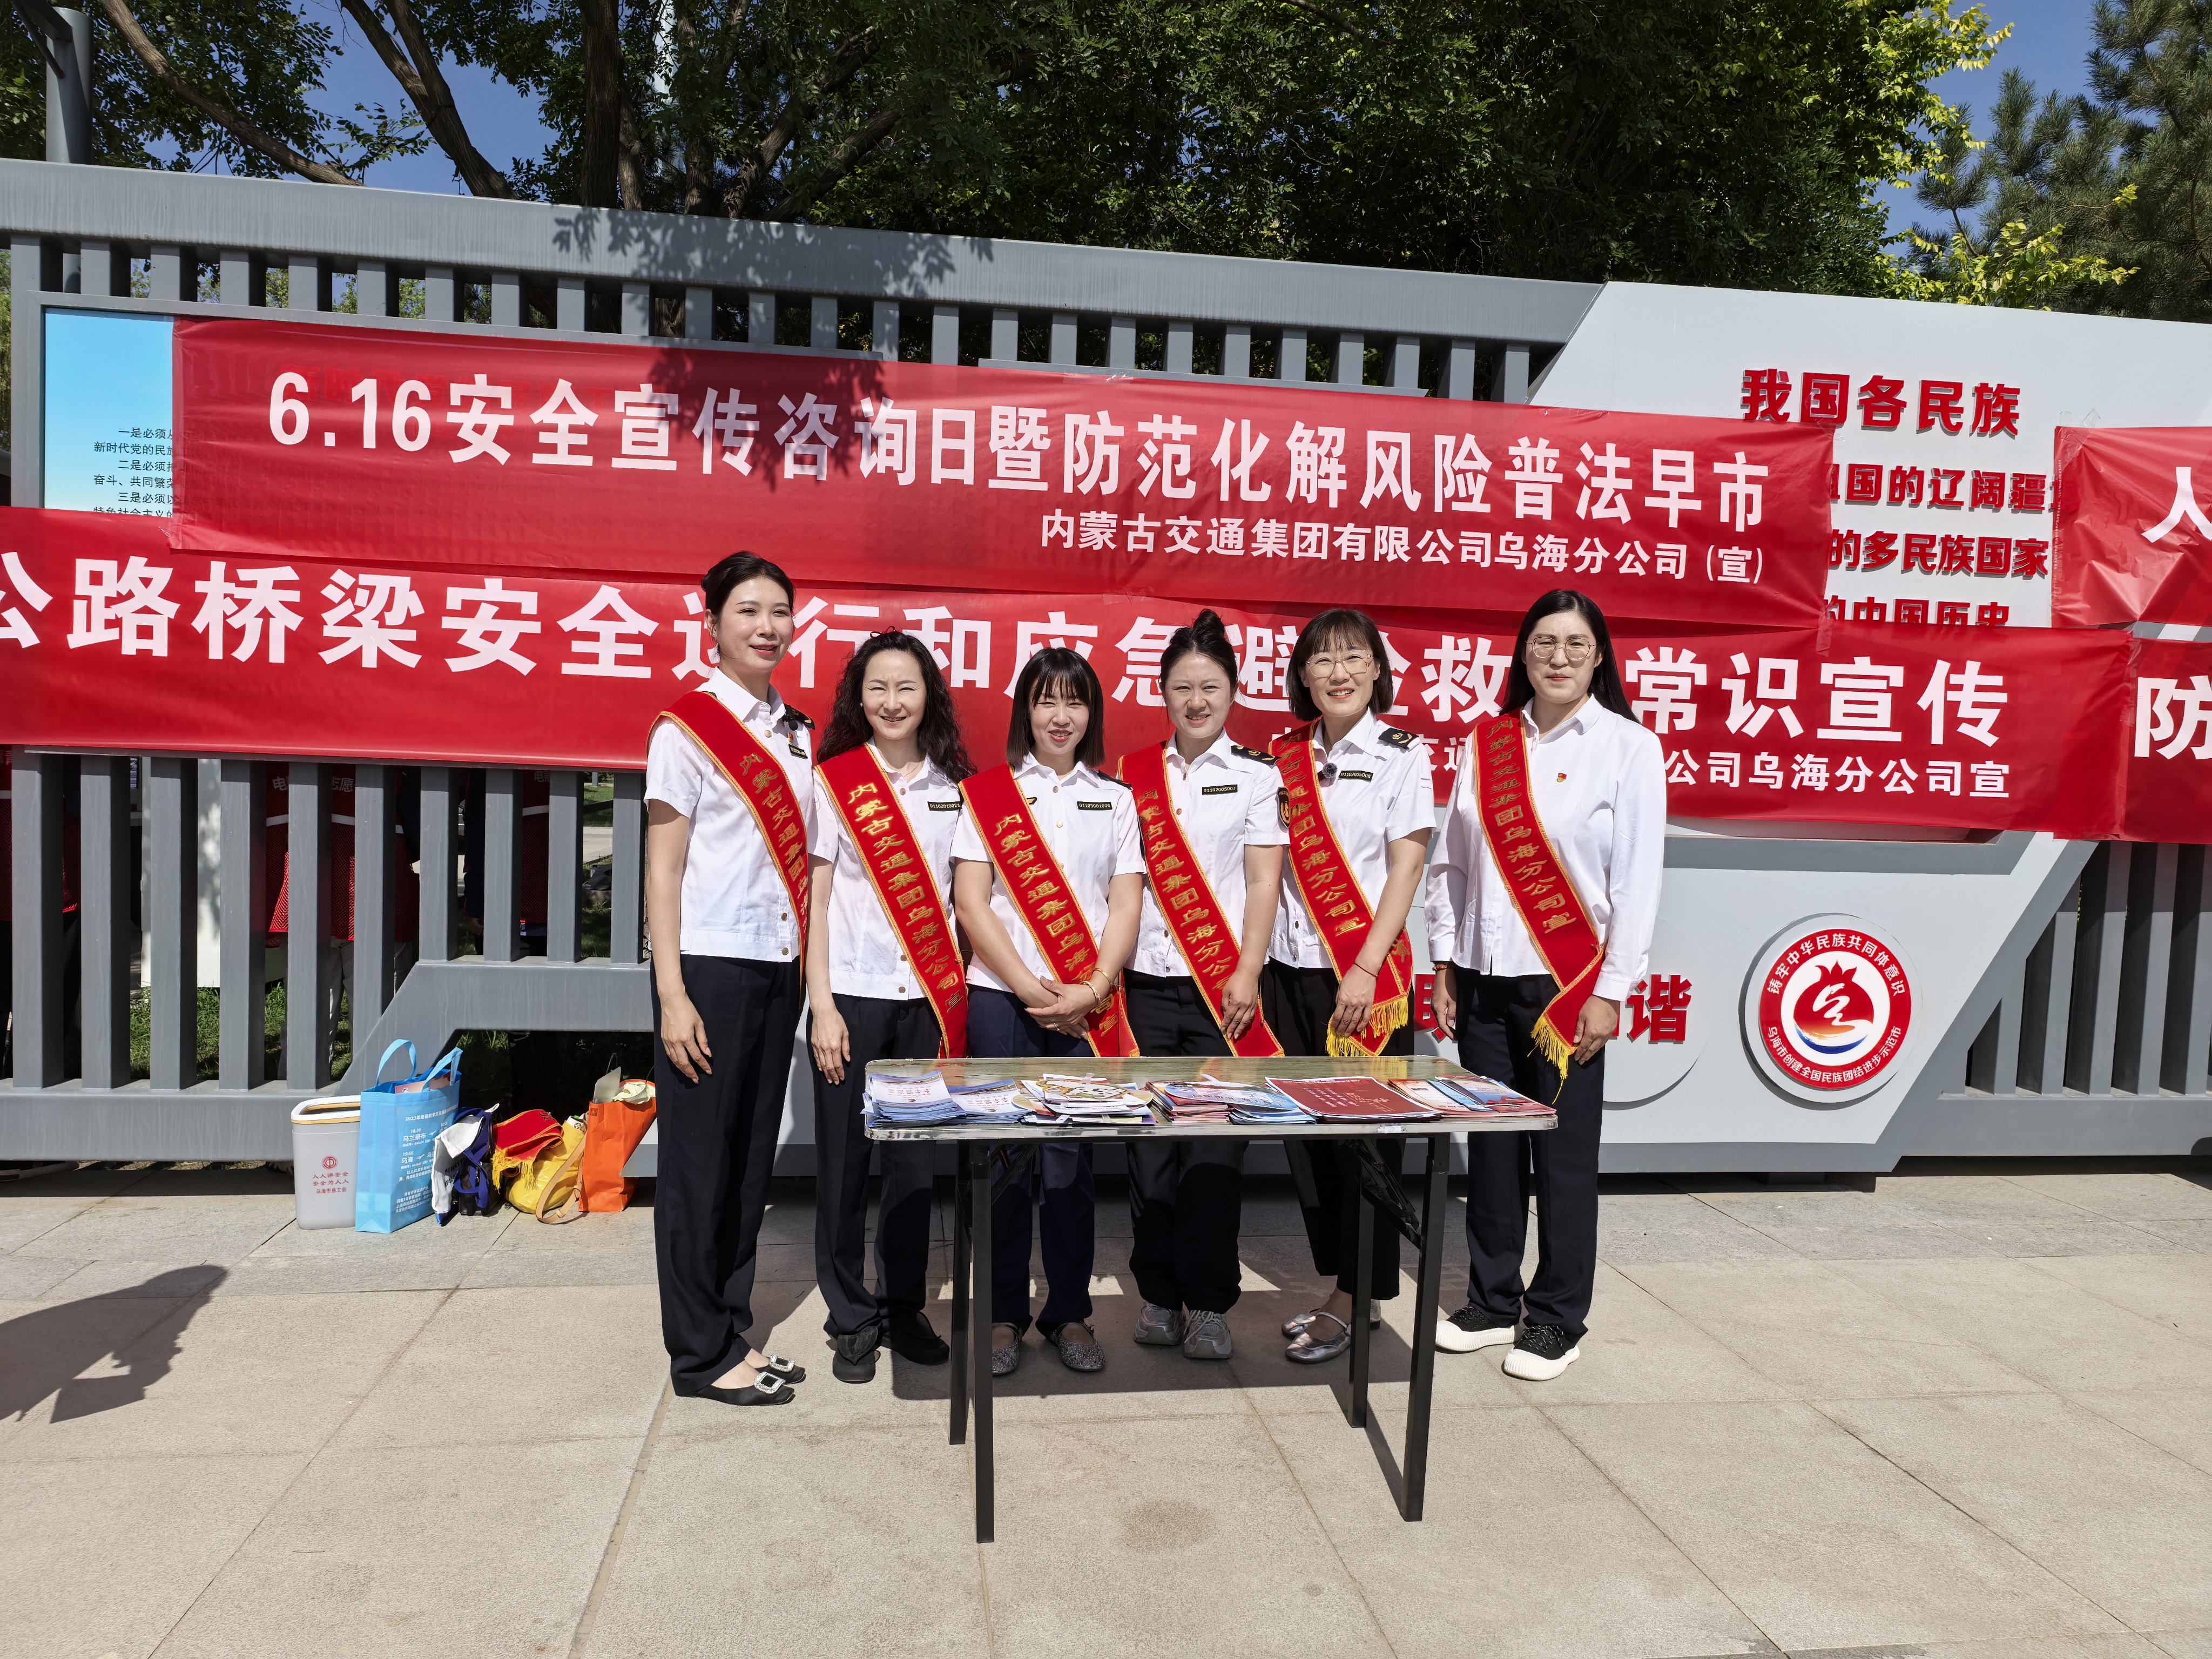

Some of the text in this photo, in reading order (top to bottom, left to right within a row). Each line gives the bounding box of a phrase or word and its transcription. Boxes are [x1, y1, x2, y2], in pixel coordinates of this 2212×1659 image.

[1742, 368, 2020, 436] 我国各民族
[270, 372, 1769, 532] 6.16安全宣传咨询日暨防范化解风险普法早市
[1831, 463, 2055, 512] 国的辽阔疆
[2142, 467, 2212, 543] 人
[2134, 676, 2212, 759] 防
[739, 752, 808, 933] 内蒙古交通集团乌海
[1486, 718, 1577, 934] 内蒙古交通集团乌海分公司宣
[847, 783, 965, 1014] 内蒙古交通集团乌海分公司宣
[1767, 933, 1905, 996] 铸牢中华民族共同体意识
[1614, 974, 1692, 1043] 谐
[1768, 1026, 1901, 1083] 乌海市创建全国民族团结进步示范市
